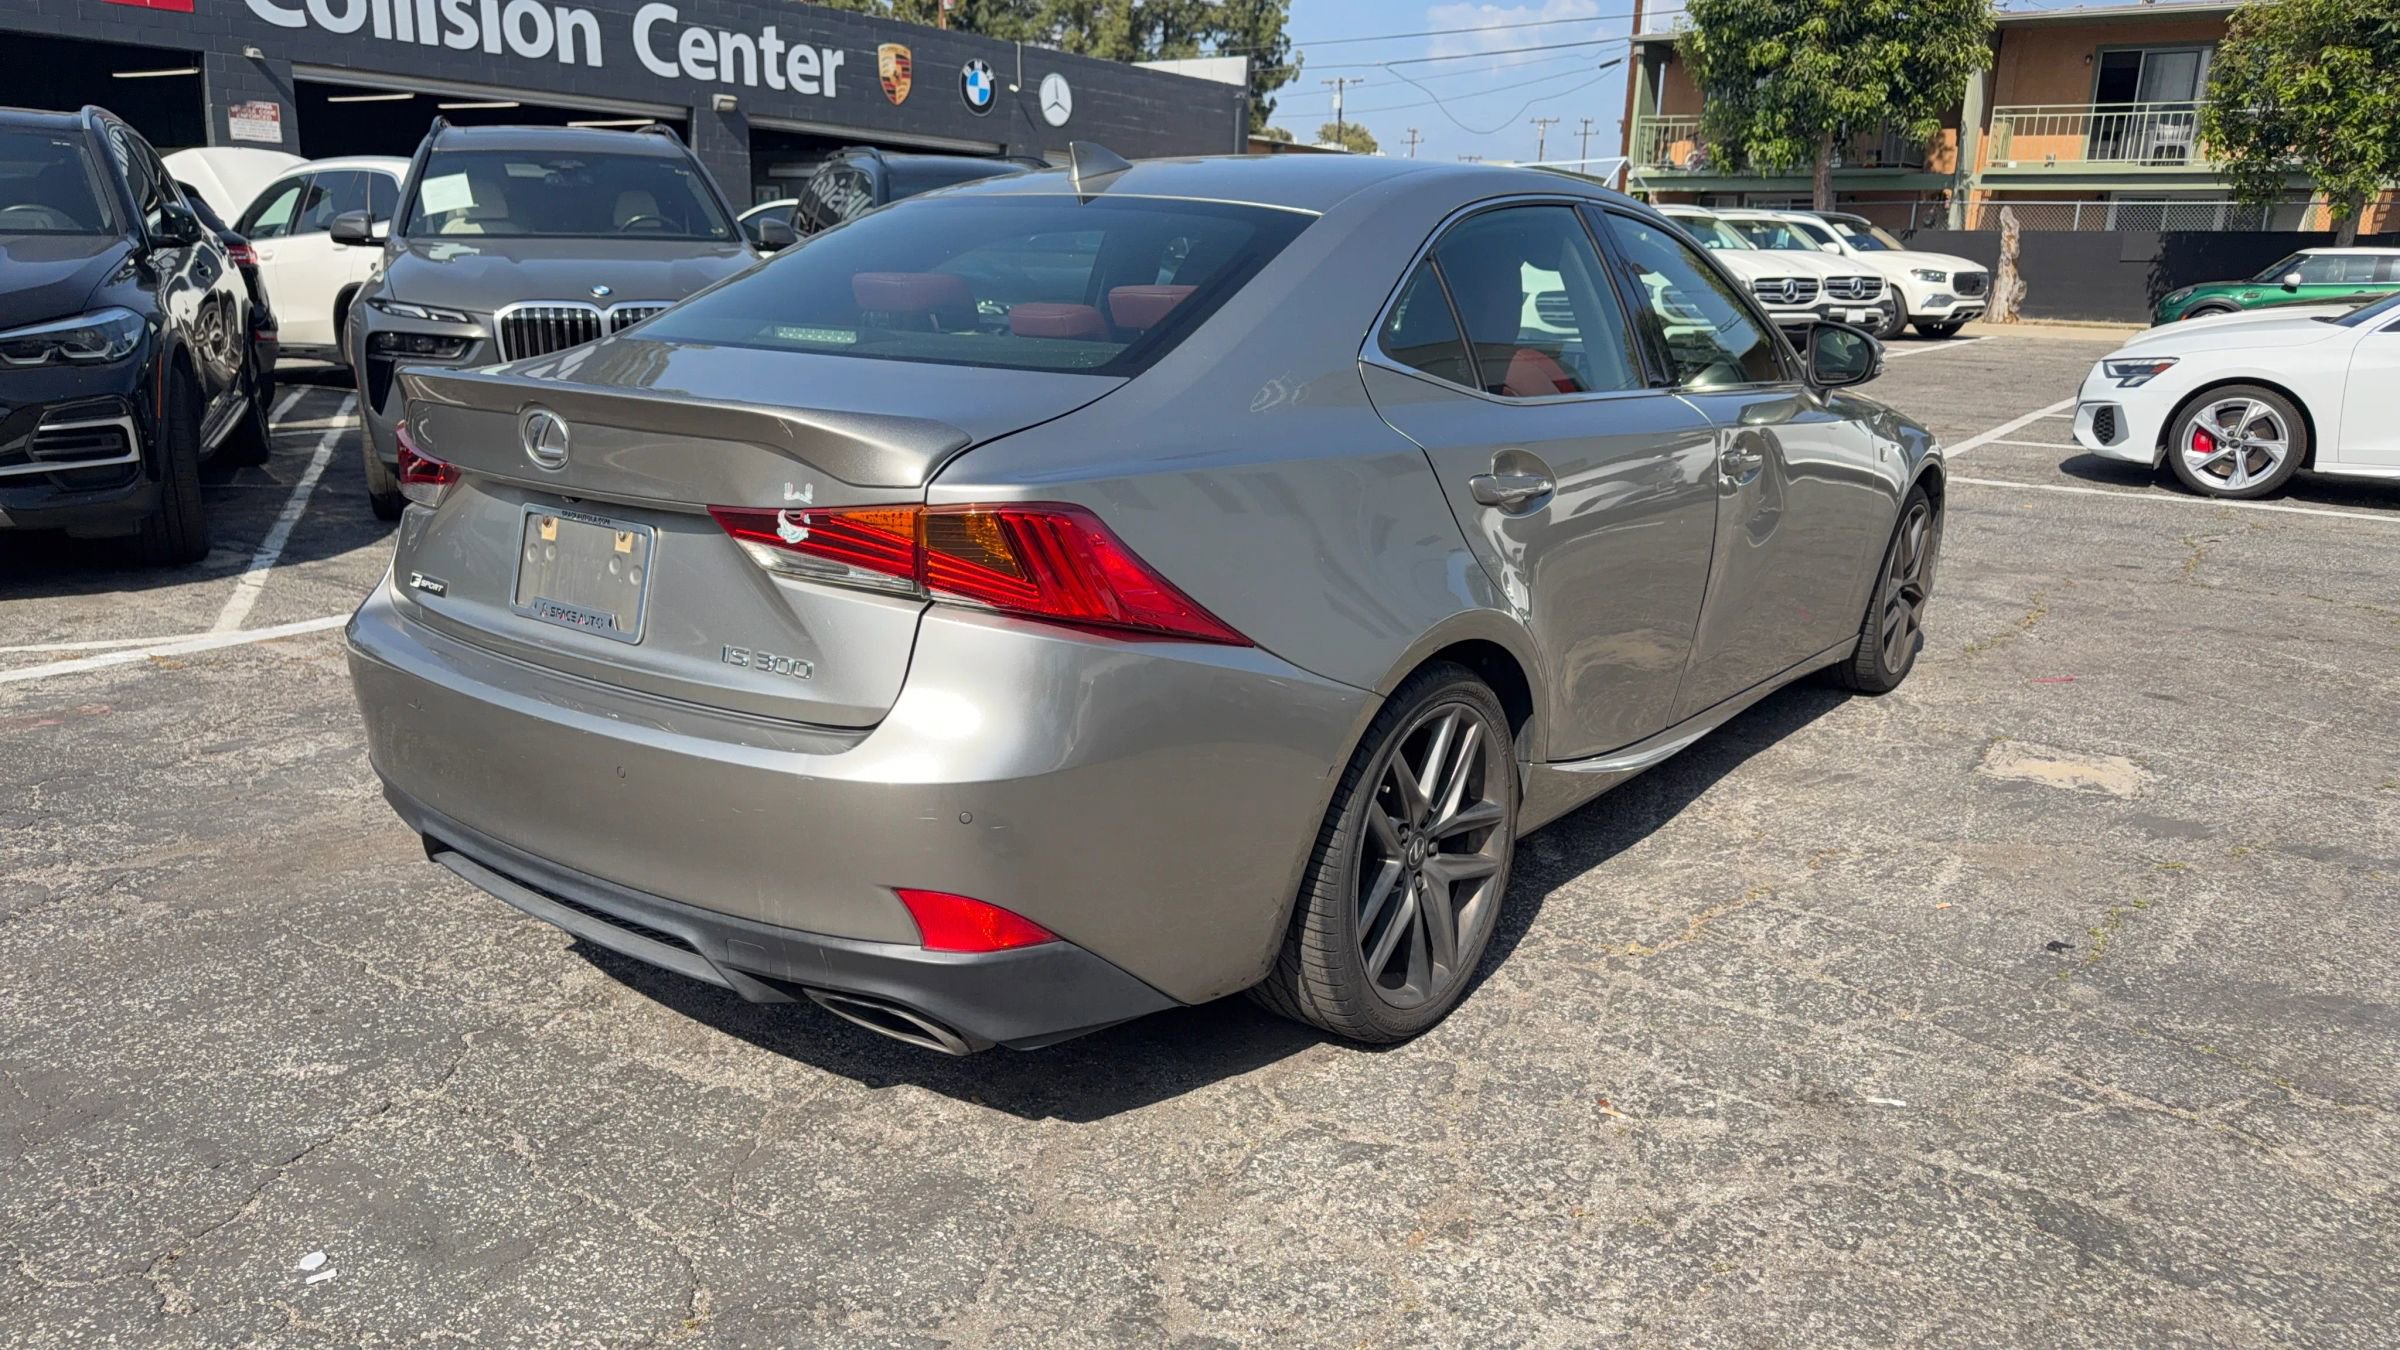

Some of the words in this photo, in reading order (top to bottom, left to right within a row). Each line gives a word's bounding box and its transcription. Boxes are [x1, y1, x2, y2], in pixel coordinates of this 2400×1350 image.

[633, 3, 844, 97] Center
[962, 59, 995, 80] BMW
[421, 579, 444, 592] SPORT
[549, 606, 577, 623] SPACE
[722, 644, 750, 667] IS
[755, 651, 814, 680] 300
